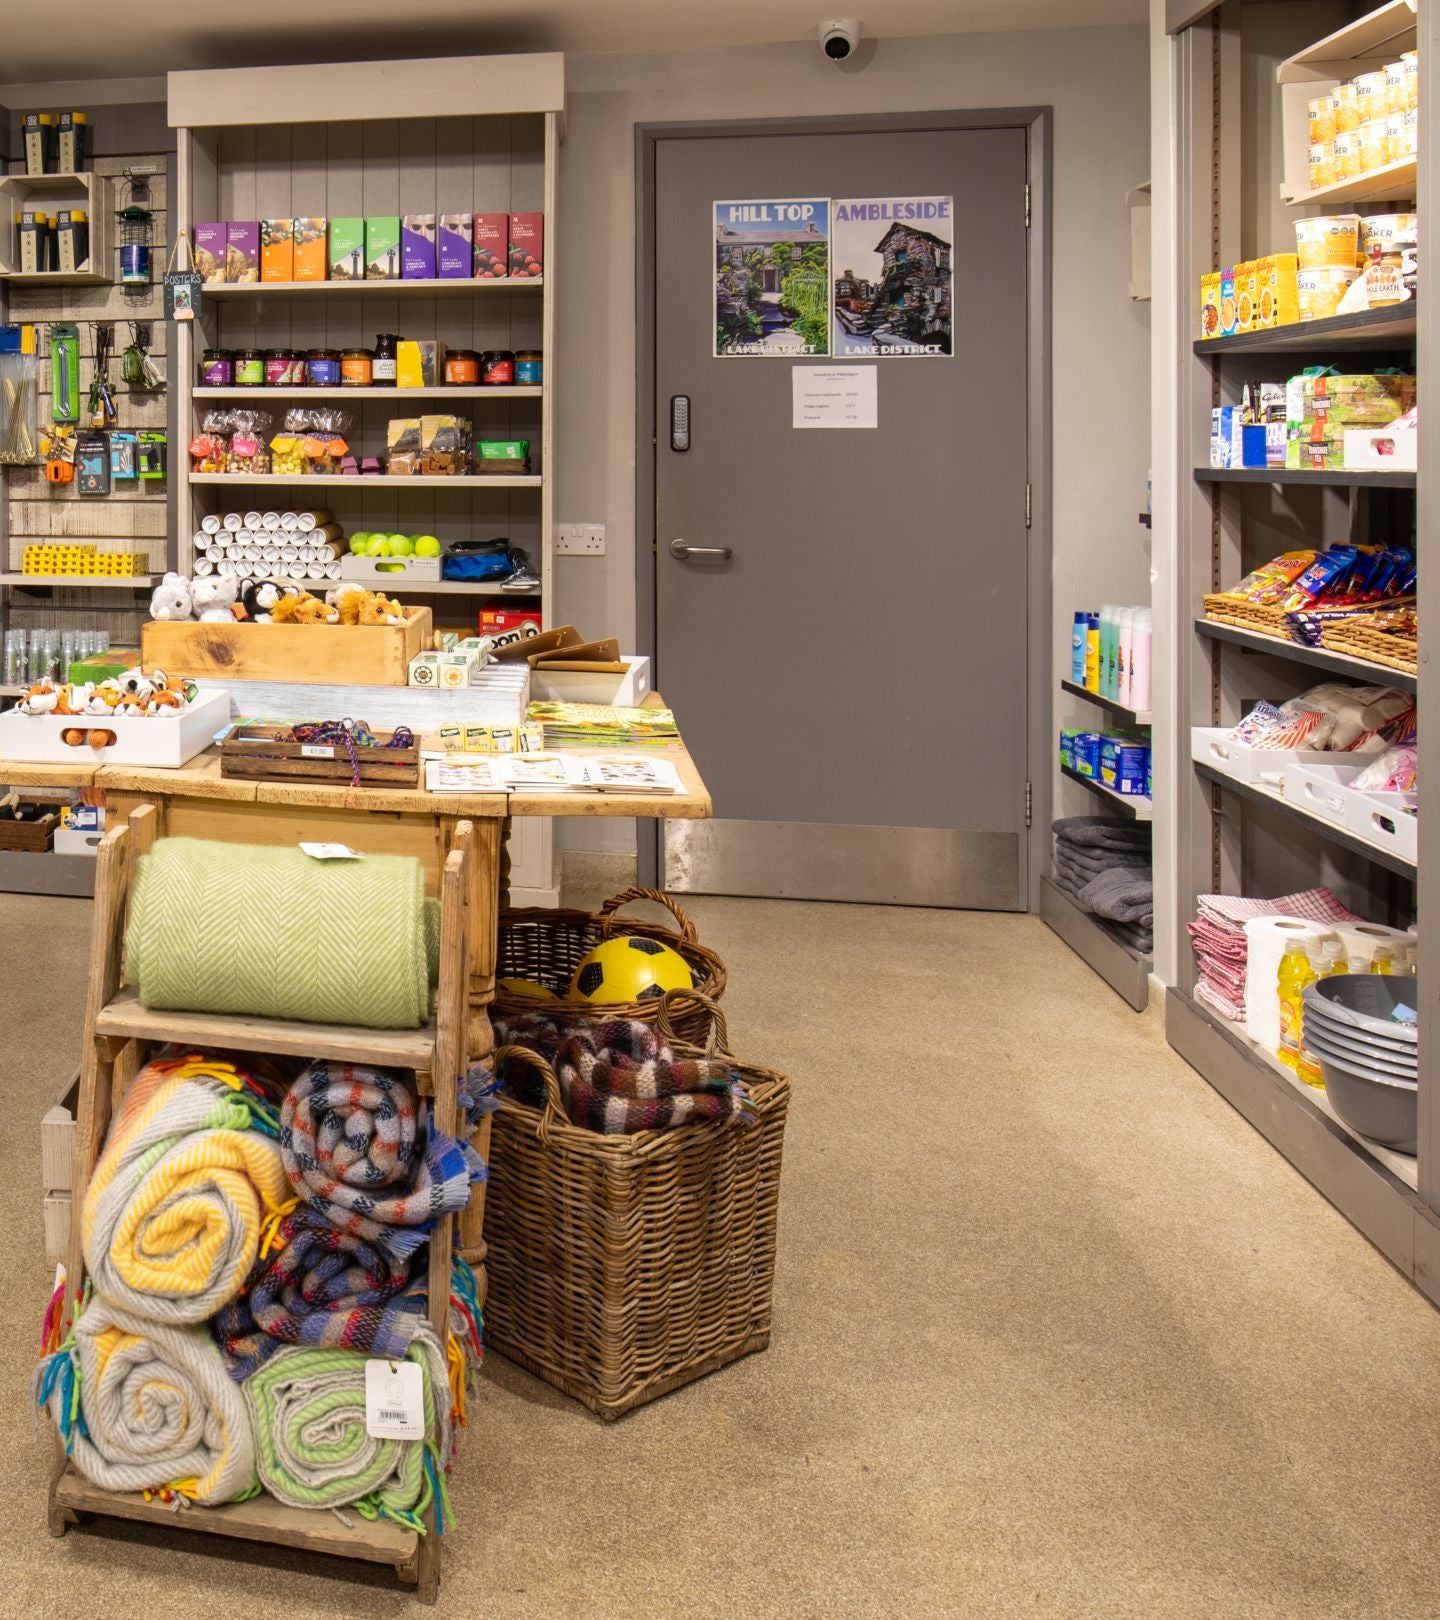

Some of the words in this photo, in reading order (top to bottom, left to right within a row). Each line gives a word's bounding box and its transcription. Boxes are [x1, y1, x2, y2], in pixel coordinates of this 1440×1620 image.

[729, 206, 772, 223] HILL
[775, 203, 814, 222] TOP
[835, 202, 950, 222] AMBLESIDE
[164, 274, 202, 285] POSTERS
[727, 345, 758, 355] LAKE
[759, 344, 816, 354] DISTRICT
[845, 345, 879, 355] LAKE
[880, 344, 942, 355] DISTRICT
